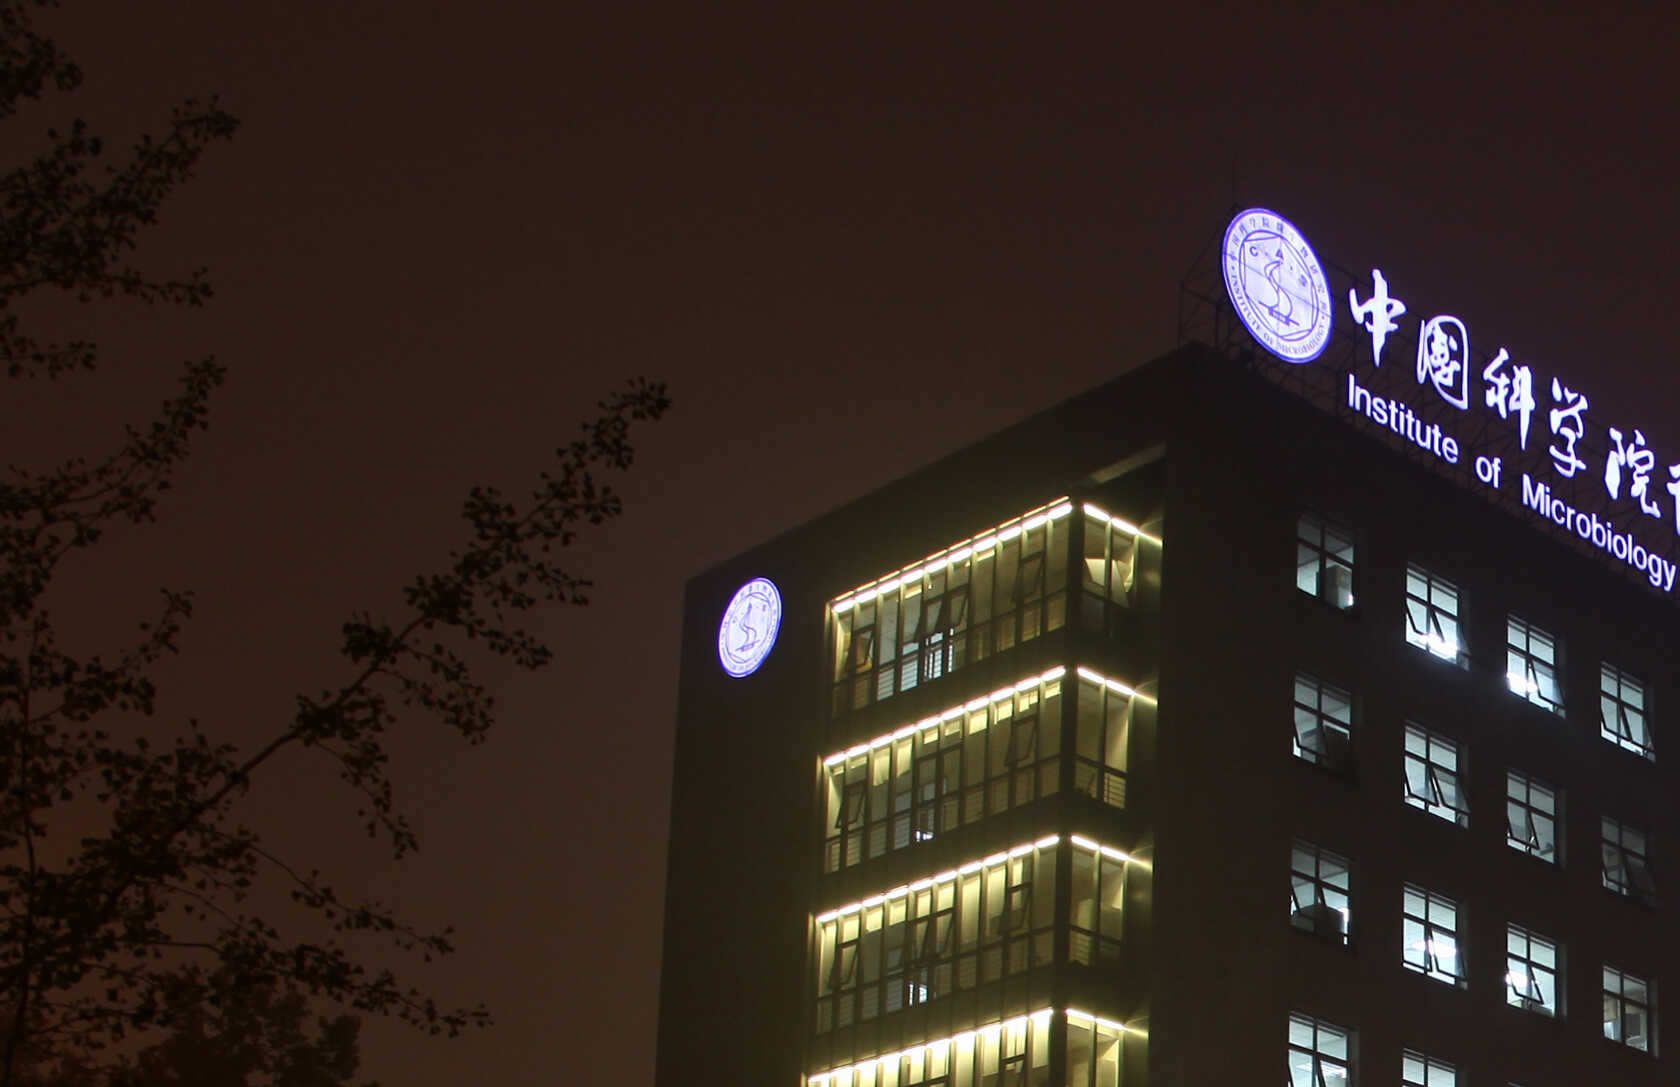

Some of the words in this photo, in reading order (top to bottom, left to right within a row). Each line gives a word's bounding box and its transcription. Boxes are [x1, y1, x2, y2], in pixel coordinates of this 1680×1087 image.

[1348, 374, 1459, 464] Institute
[1475, 456, 1502, 489] of
[1522, 473, 1677, 592] Microbiology
